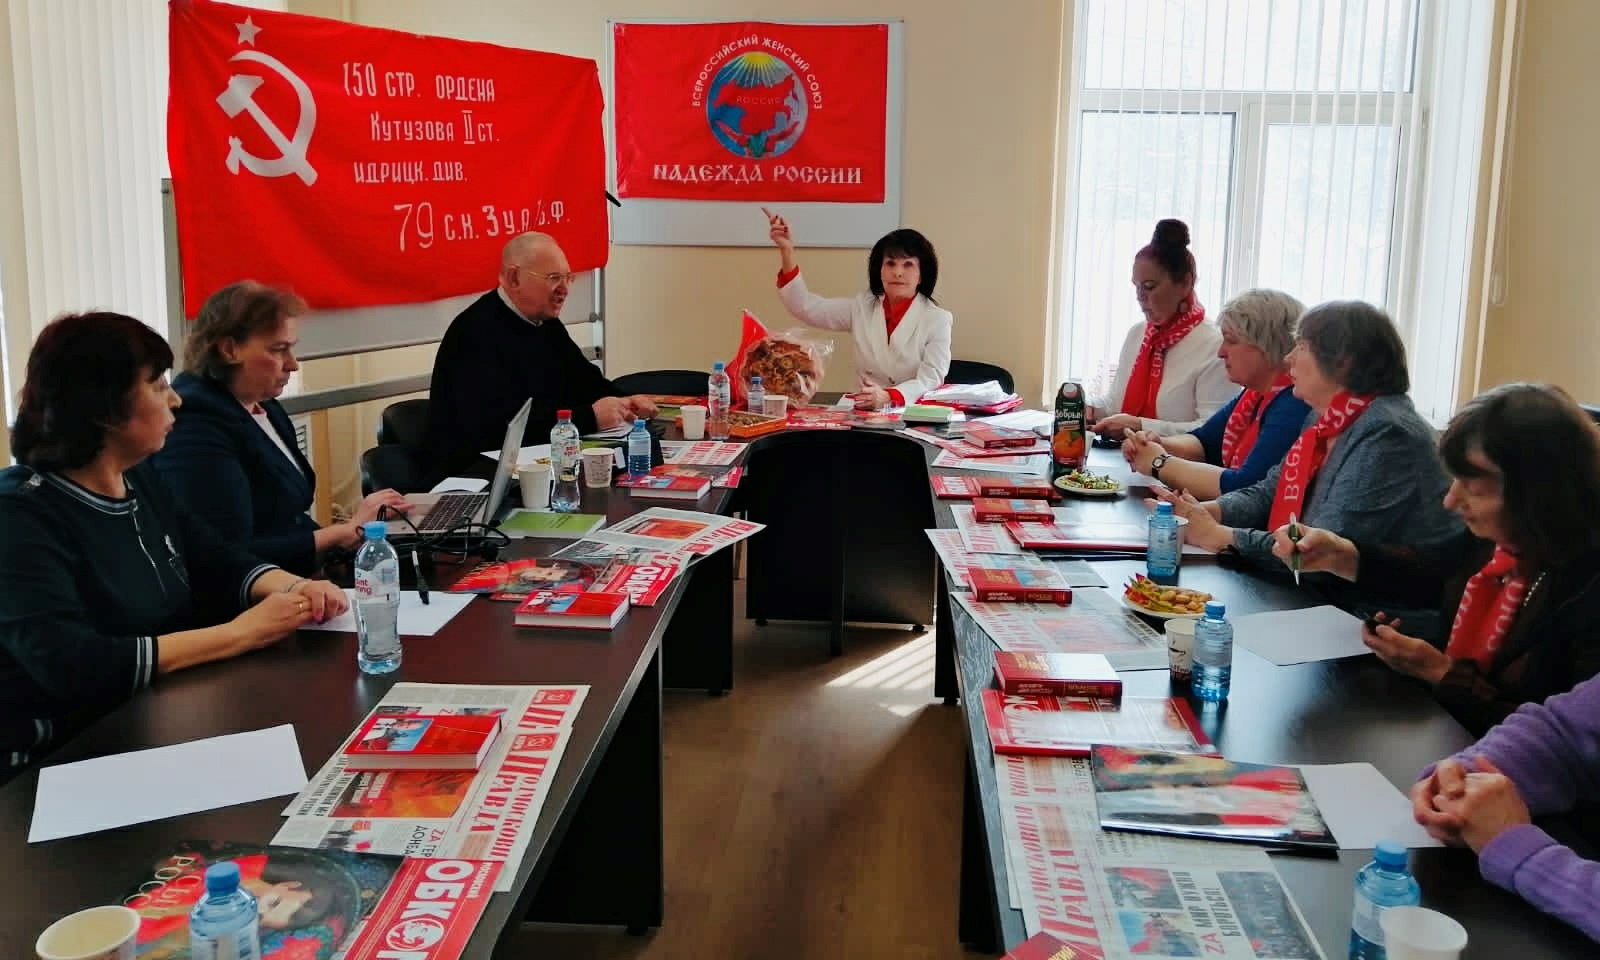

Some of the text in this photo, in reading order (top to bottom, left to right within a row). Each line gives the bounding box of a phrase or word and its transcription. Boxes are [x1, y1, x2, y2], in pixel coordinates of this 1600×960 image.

[342, 61, 377, 97] 150
[435, 74, 495, 102] ОРДЕНА
[692, 33, 823, 110] ВСЕРОССИЙСКИЙ ЖЕНСКИЙ СОЮЗ
[653, 163, 863, 185] НАДЕЖДА РОССИИ
[393, 201, 434, 253] 79
[481, 205, 499, 236] 3
[403, 825, 423, 858] ДОНБА
[424, 844, 438, 858] ГЕР
[124, 854, 198, 906] РОСС
